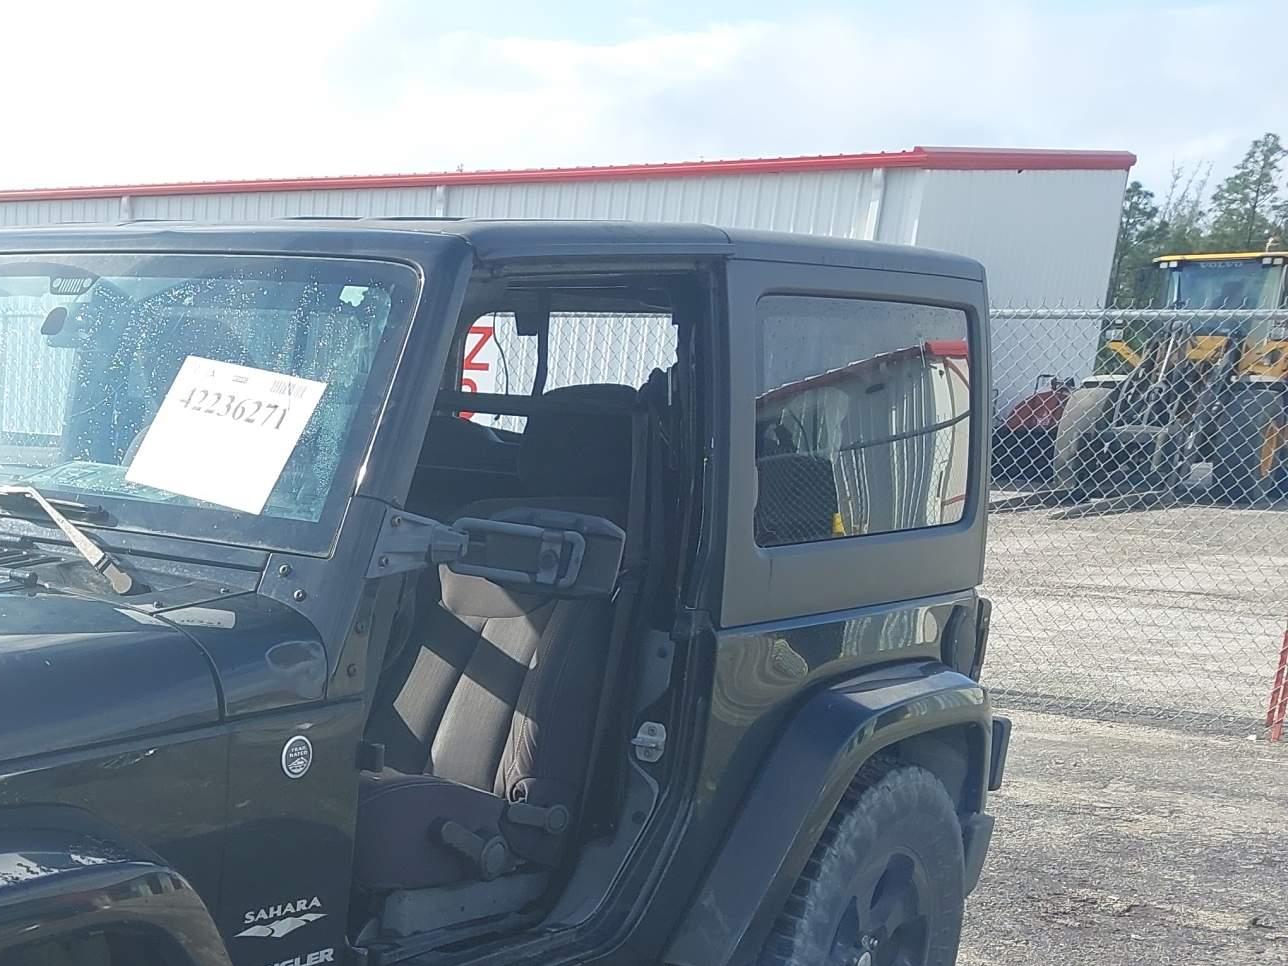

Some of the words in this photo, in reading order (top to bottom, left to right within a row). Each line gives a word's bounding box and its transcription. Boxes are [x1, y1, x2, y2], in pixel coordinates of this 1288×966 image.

[1199, 261, 1244, 269] VOLVO
[180, 387, 288, 430] 42236271
[243, 896, 322, 924] SAHARA
